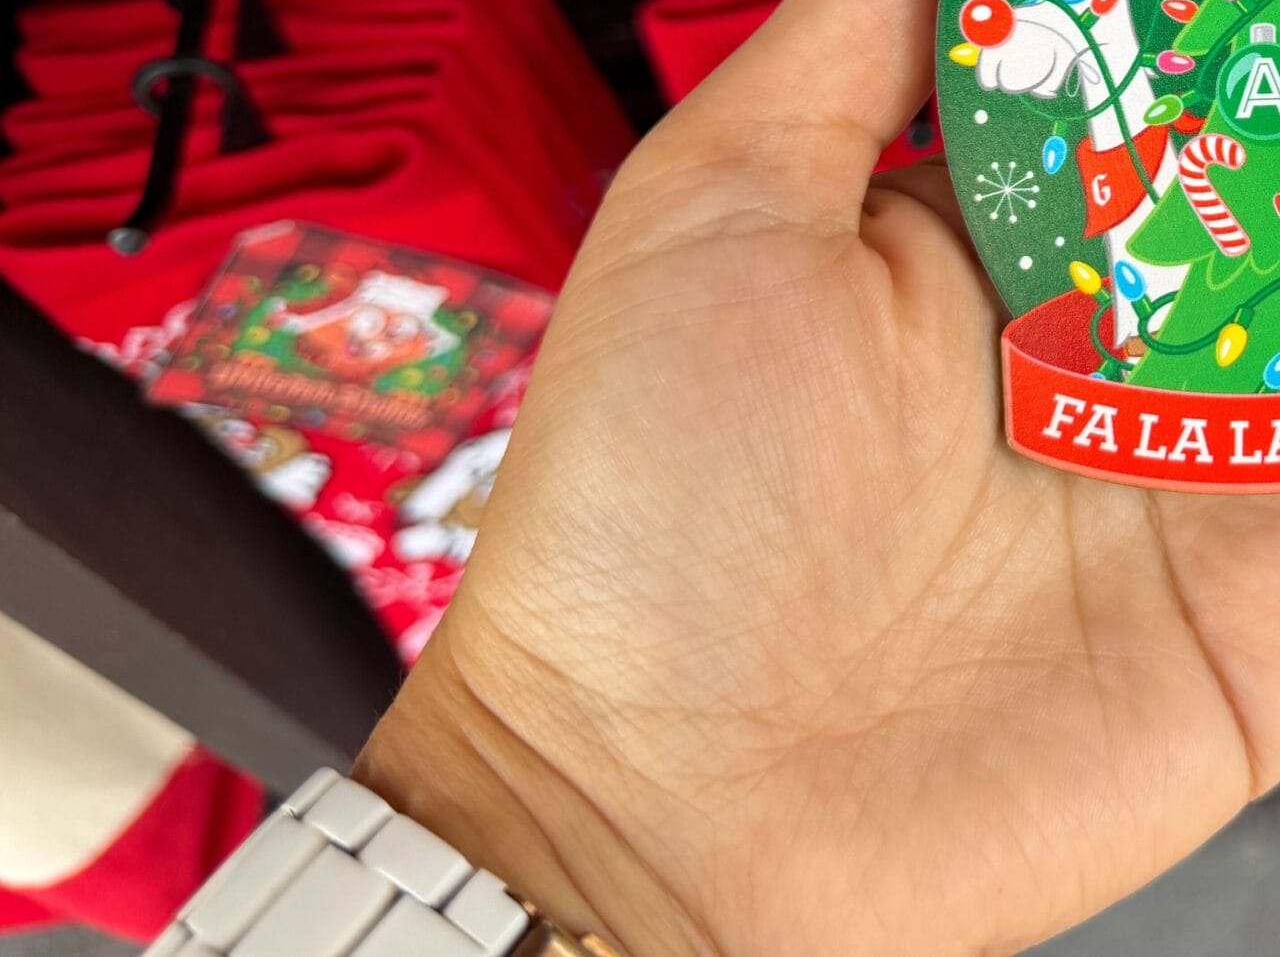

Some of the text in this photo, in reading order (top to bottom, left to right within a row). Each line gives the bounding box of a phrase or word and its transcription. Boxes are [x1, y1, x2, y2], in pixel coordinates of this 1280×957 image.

[1091, 172, 1112, 207] G
[1042, 392, 1119, 453] FA
[1131, 412, 1214, 463] LA
